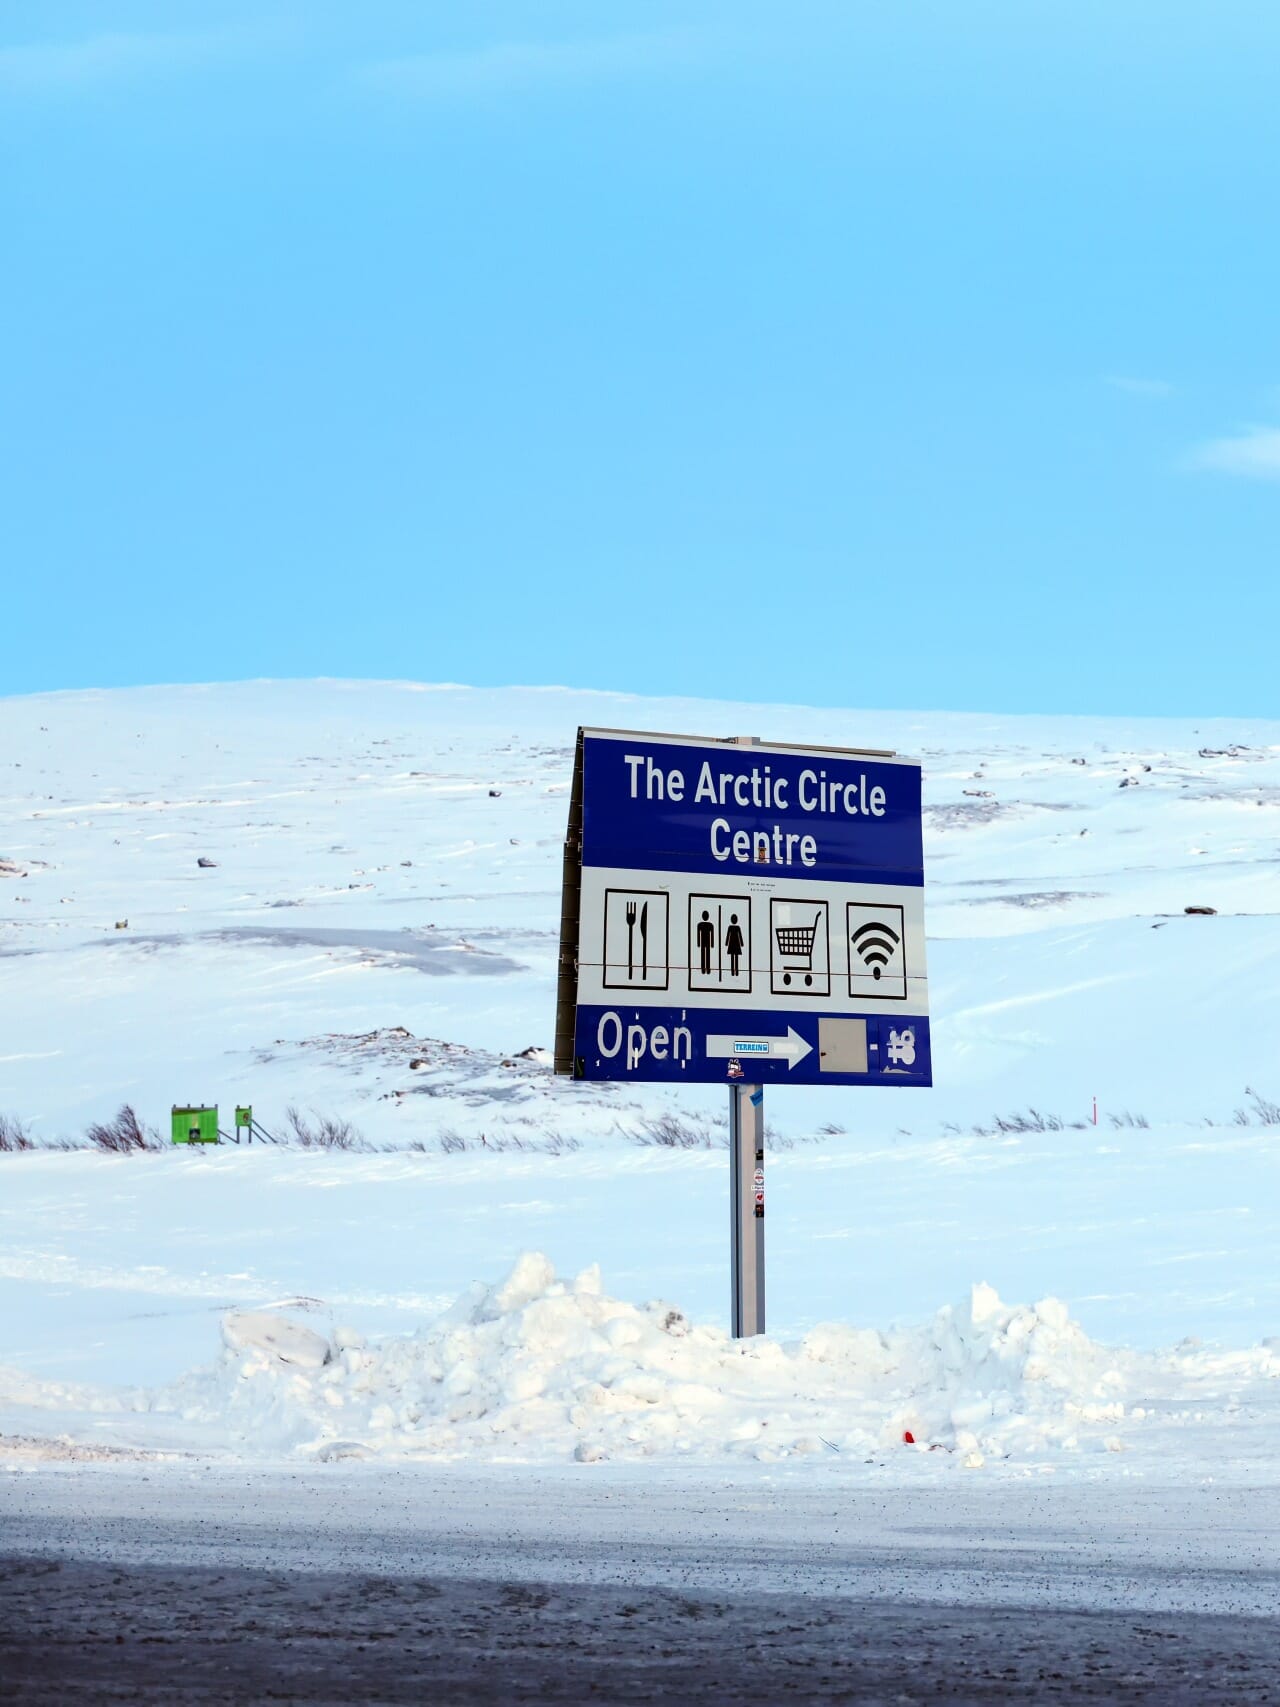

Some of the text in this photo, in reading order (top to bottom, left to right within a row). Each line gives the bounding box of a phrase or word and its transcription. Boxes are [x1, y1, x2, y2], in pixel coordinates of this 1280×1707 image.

[624, 754, 886, 817] The Arctic Circle
[710, 817, 817, 867] Centre
[597, 1011, 692, 1071] Open
